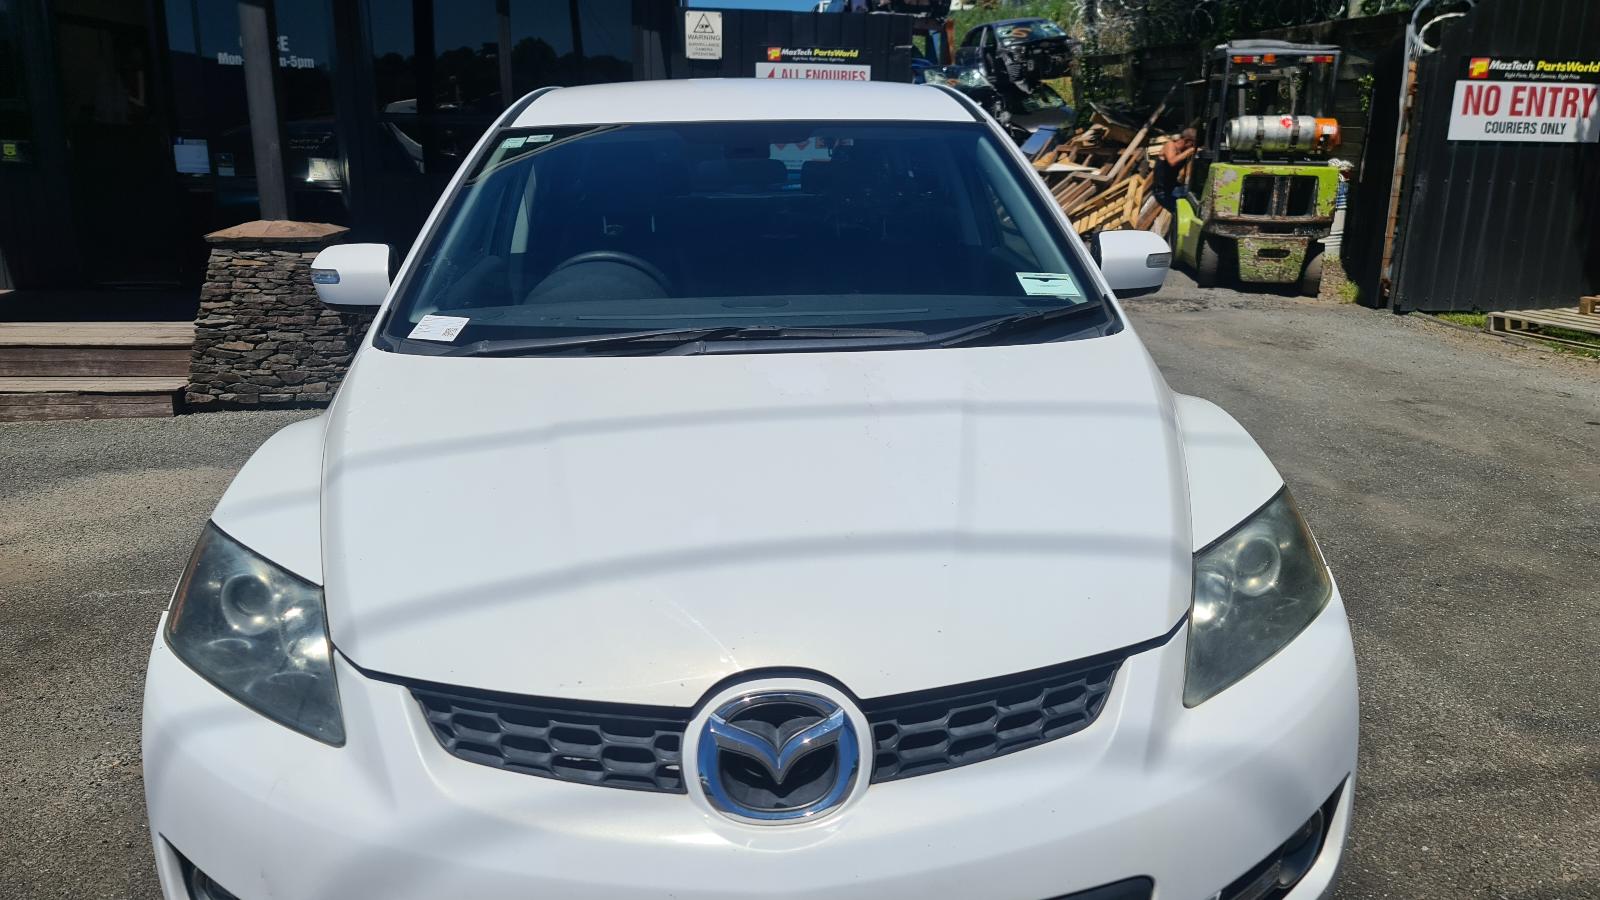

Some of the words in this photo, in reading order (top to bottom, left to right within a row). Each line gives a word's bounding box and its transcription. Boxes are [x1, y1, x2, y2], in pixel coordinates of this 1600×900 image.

[217, 52, 245, 66] Mon-
[813, 48, 859, 58] PartsWorld
[1535, 60, 1600, 73] PartsWorld
[1461, 84, 1502, 116] NO
[1509, 85, 1598, 119] ENTRY
[1484, 121, 1538, 135] COURIERS
[1540, 122, 1567, 135] ONLY
